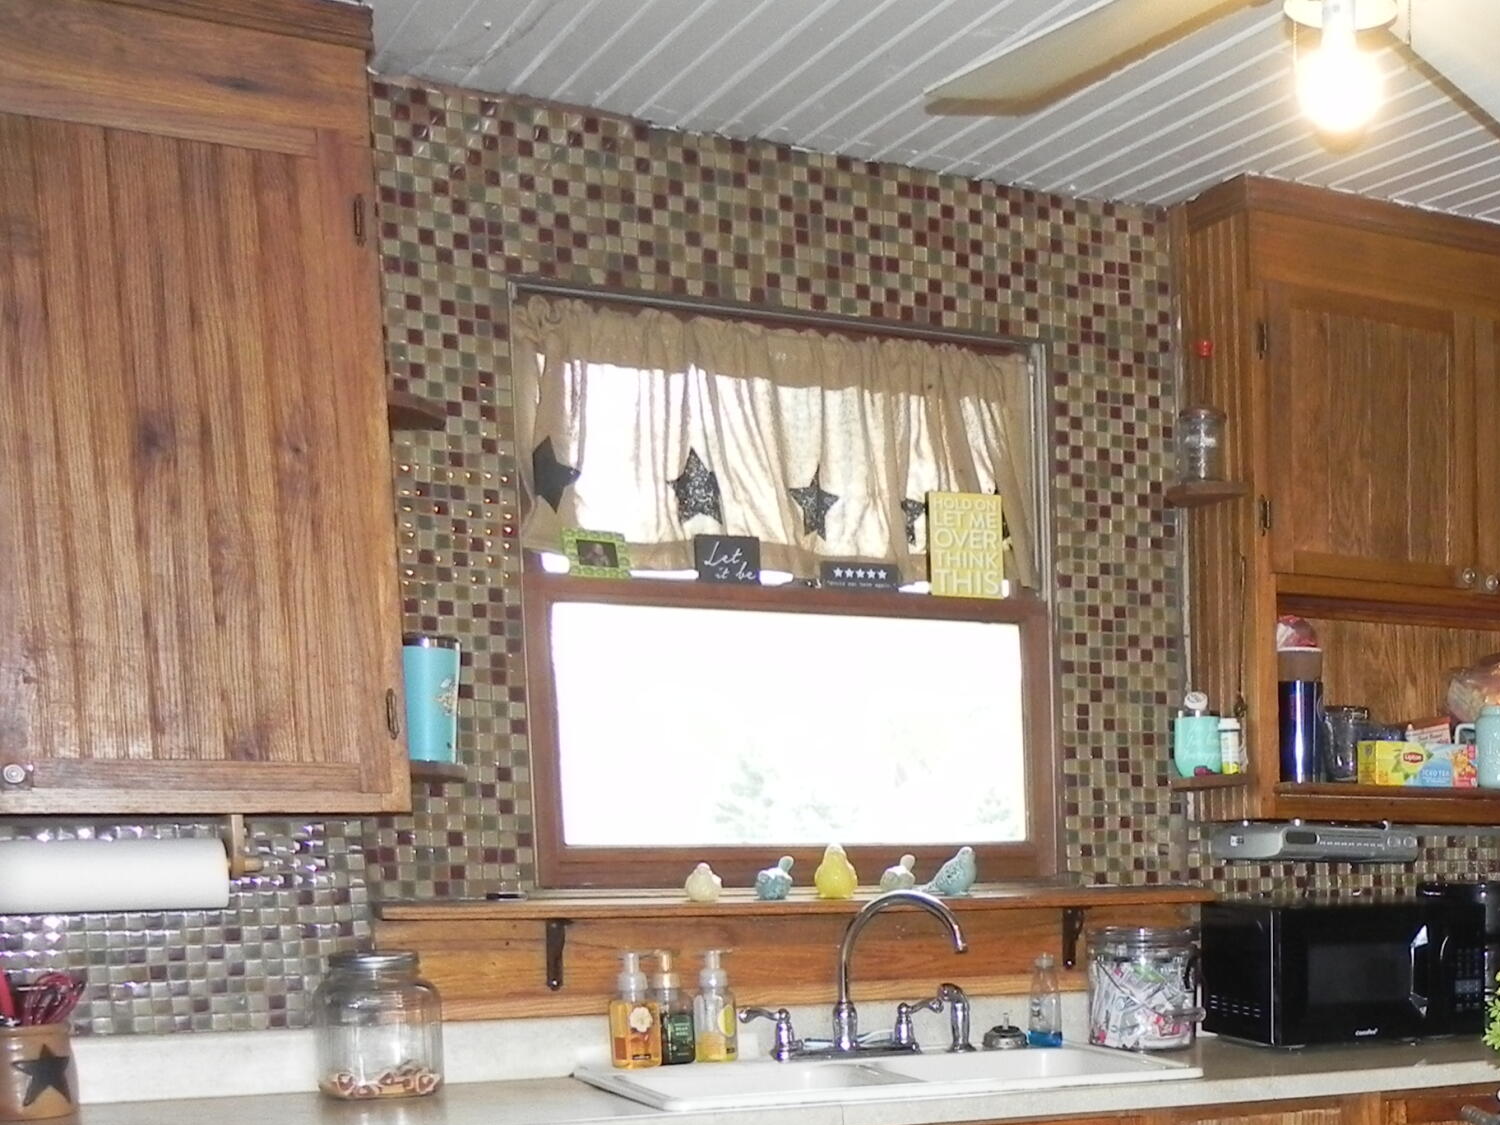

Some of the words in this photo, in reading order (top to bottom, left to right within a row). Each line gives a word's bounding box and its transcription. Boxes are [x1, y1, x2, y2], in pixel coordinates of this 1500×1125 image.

[935, 498, 972, 510] HOLD
[974, 499, 997, 512] ON
[934, 511, 964, 527] LET
[970, 513, 997, 529] ME
[935, 528, 997, 550] OVER
[704, 541, 742, 566] Let
[935, 549, 998, 569] THINK
[714, 567, 730, 579] it
[736, 561, 756, 580] be
[934, 569, 999, 595] THIS
